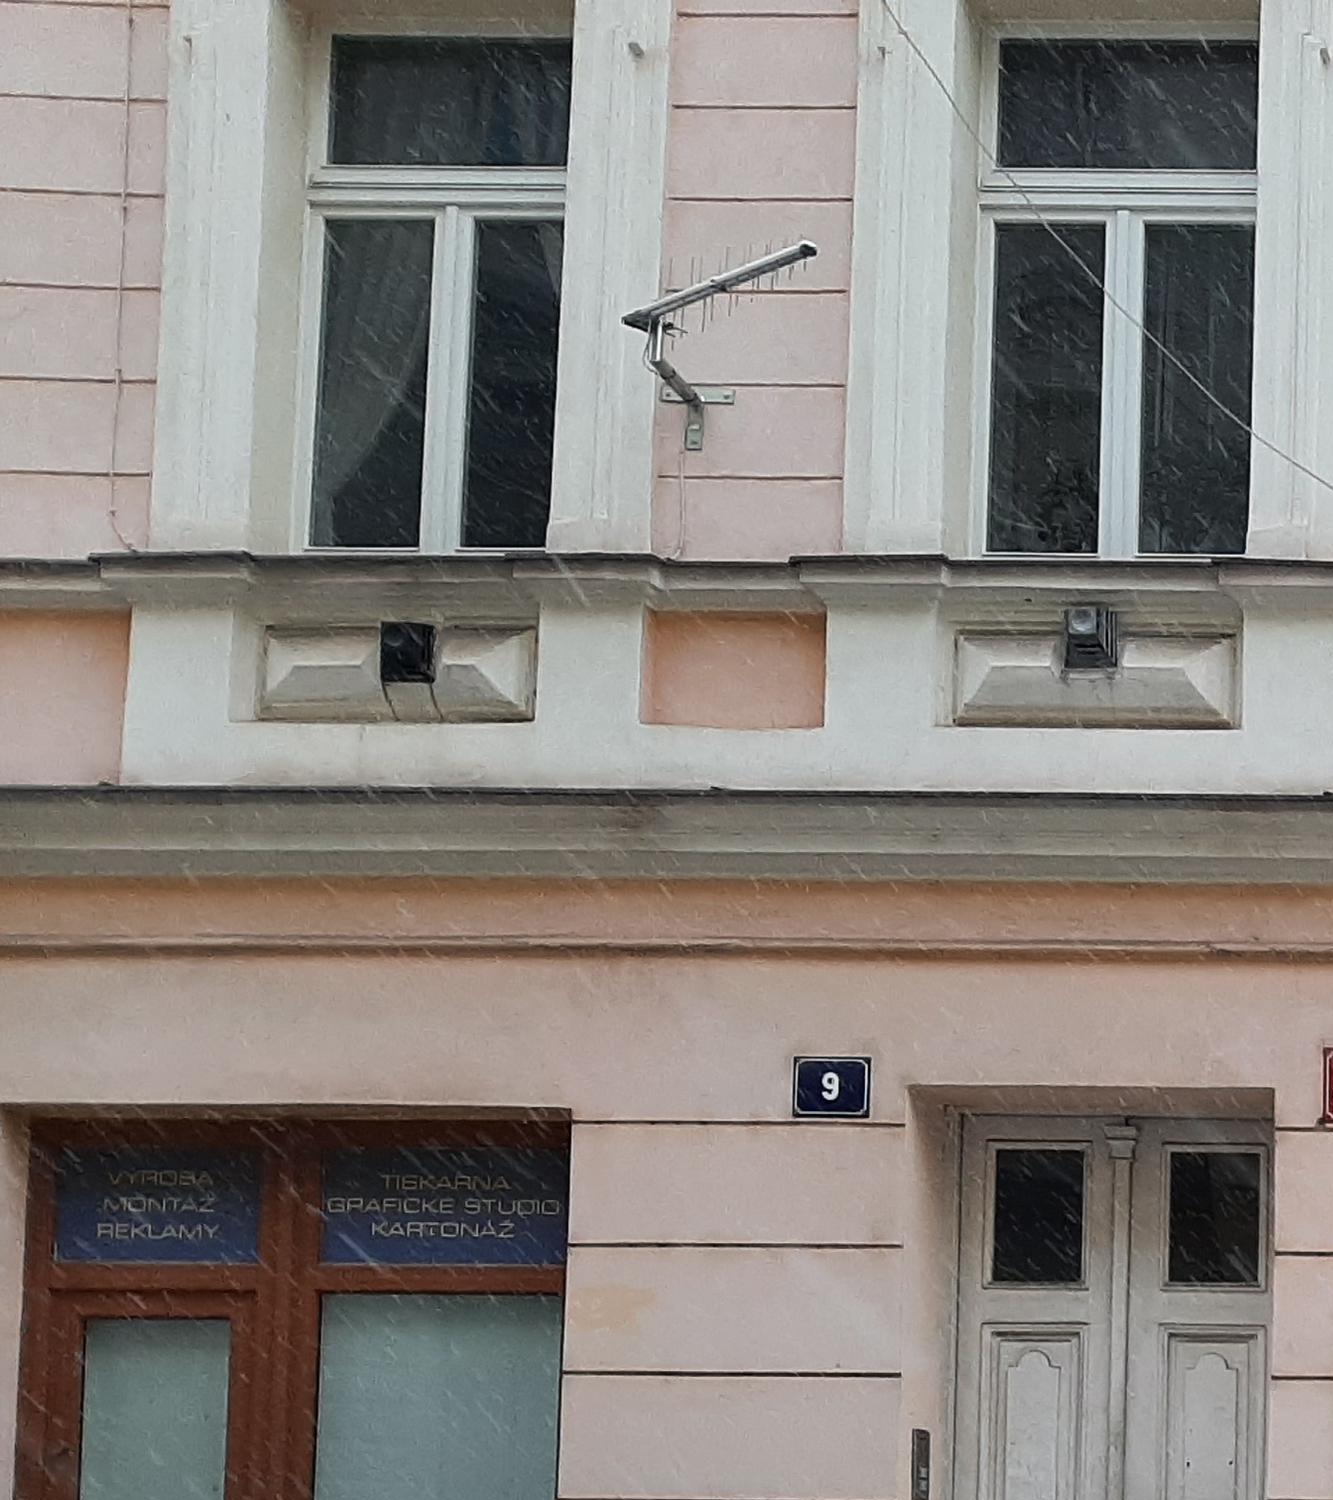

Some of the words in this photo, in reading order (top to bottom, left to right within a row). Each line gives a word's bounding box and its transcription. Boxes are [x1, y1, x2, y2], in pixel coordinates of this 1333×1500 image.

[821, 1071, 840, 1101] 9
[464, 1199, 561, 1216] STUDIO
[96, 1223, 220, 1239] REKLAMY
